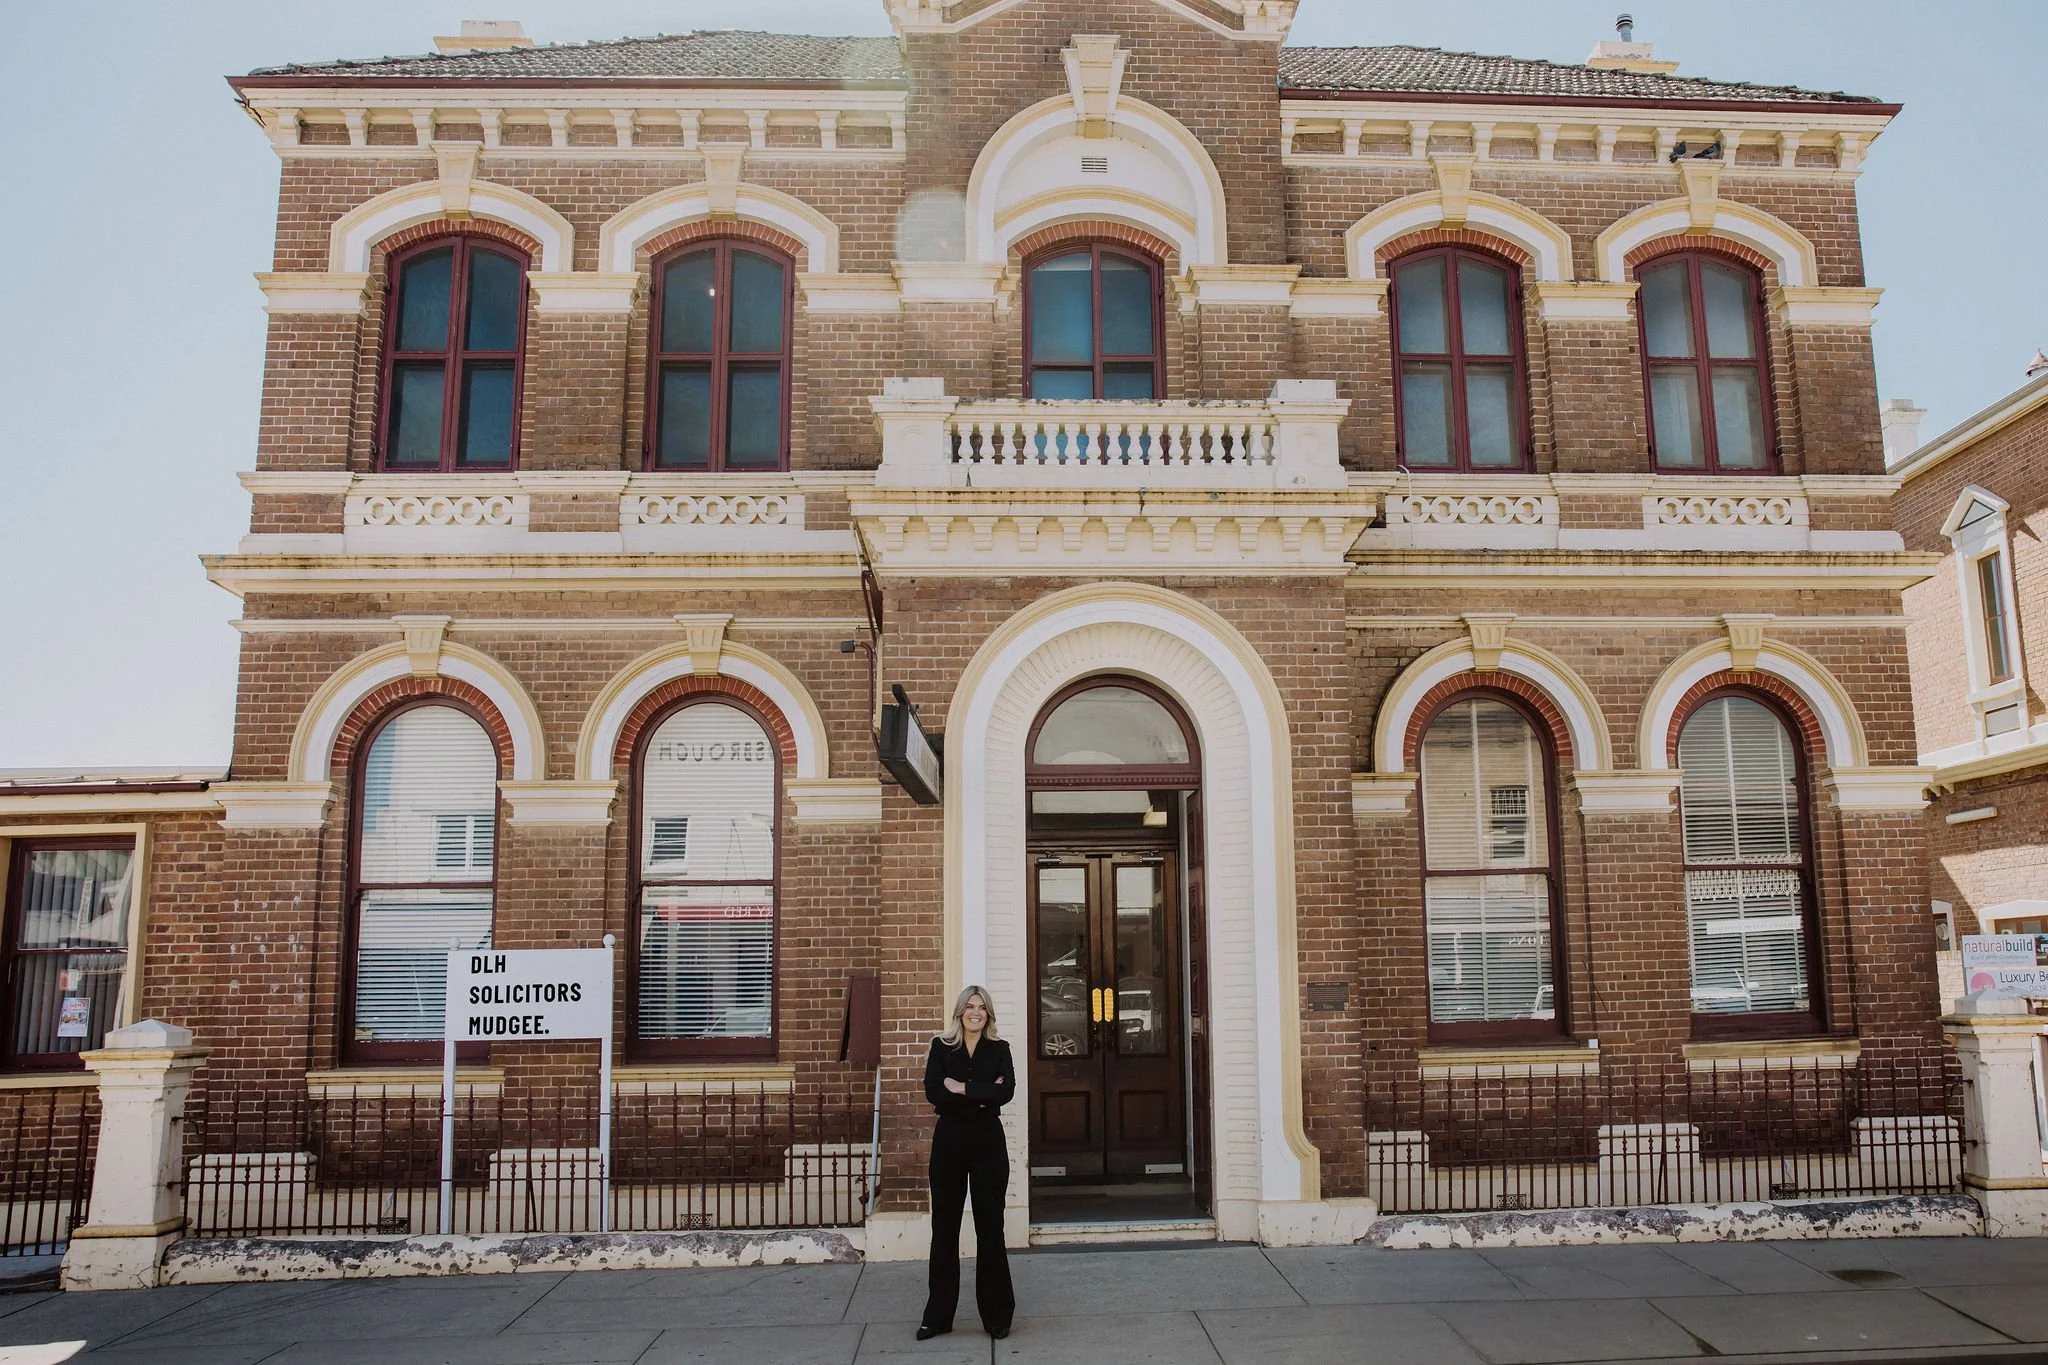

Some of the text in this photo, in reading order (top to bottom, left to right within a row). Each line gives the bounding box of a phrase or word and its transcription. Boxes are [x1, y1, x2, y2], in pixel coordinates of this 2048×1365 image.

[1964, 939, 2033, 953] naturalbuild
[471, 954, 507, 974] DLH
[2000, 971, 2036, 984] Luxury
[469, 982, 582, 1004] SOLICITORS
[468, 1015, 550, 1035] MUDGEE.
